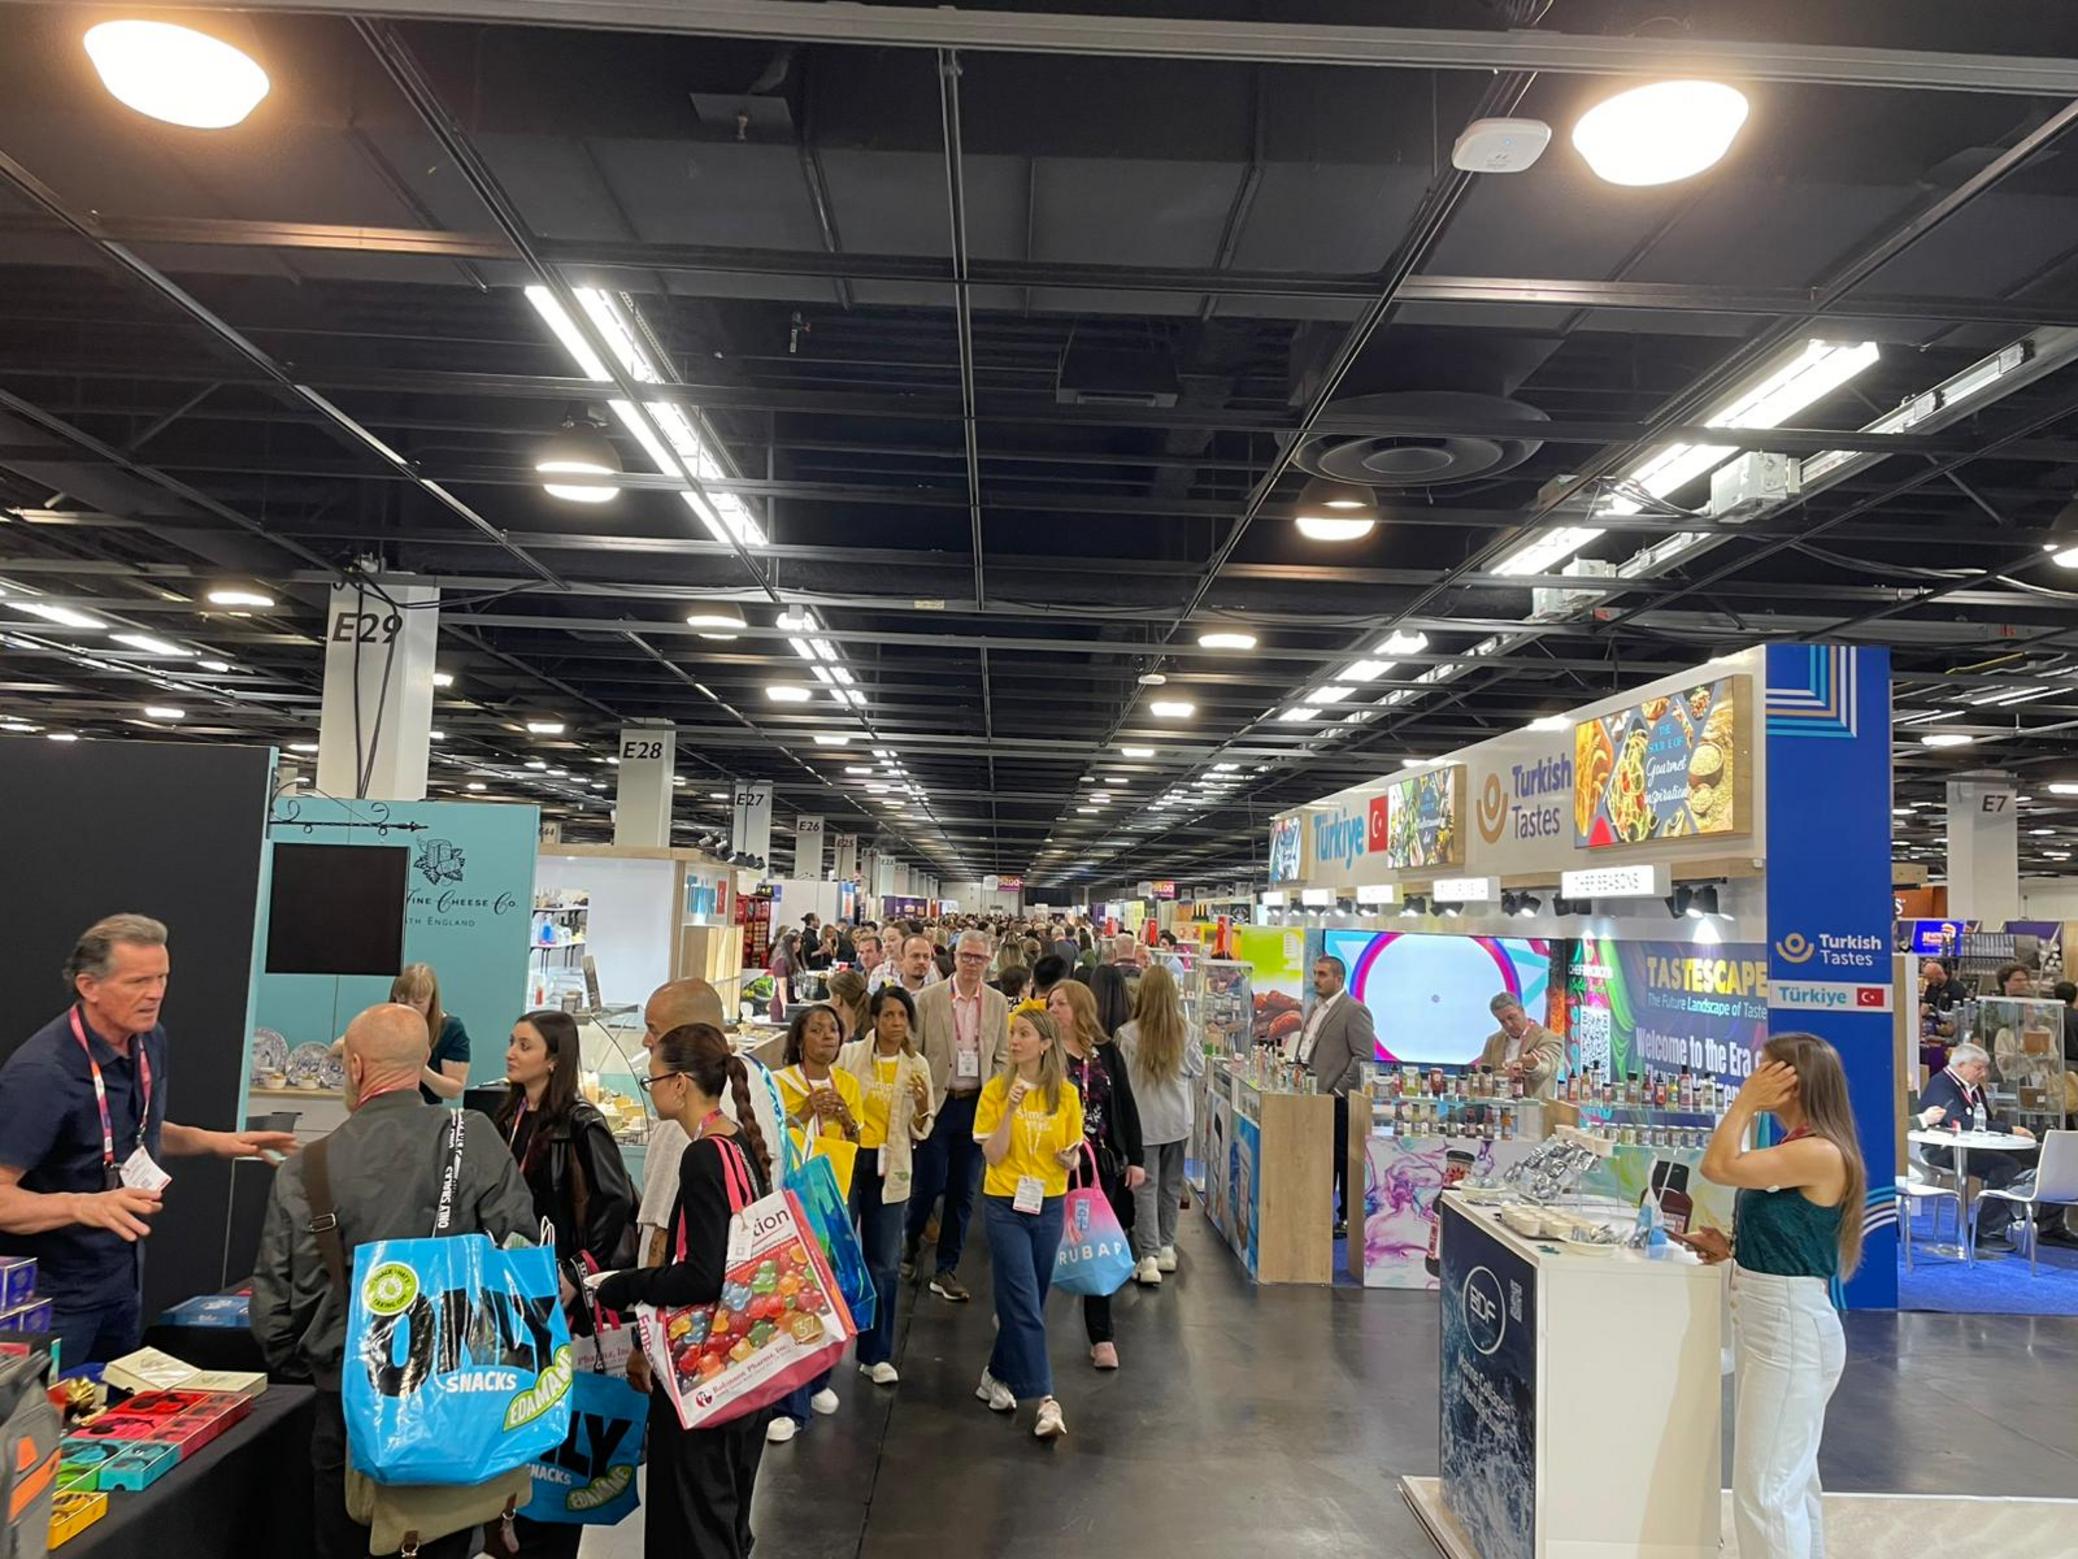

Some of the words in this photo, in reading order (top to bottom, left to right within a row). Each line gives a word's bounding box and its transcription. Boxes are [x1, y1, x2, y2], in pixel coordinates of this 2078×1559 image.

[332, 612, 403, 643] E29
[623, 742, 662, 760] E28
[1512, 753, 1571, 798] Turkish
[1646, 756, 1687, 787] Gourmet
[737, 793, 764, 806] E27
[1982, 794, 2008, 813] E7
[799, 821, 820, 832] E26
[1512, 804, 1560, 839] Tastes
[1314, 809, 1364, 870] Türkiye
[437, 889, 489, 913] CHEESE
[428, 917, 476, 927] ENGLAND
[1819, 934, 1882, 950] Turkish
[1820, 949, 1873, 966] Tastes
[1647, 957, 1767, 998] TASTESCAPE
[1648, 992, 1661, 1006] The
[1662, 994, 1687, 1010] Future
[1687, 997, 1730, 1017] Landscape
[1732, 1001, 1742, 1016] of
[1744, 1003, 1767, 1020] Taste
[1779, 986, 1847, 1007] Türkiye
[1636, 1027, 1687, 1066] Welcome
[1690, 1036, 1703, 1069] to
[1705, 1038, 1727, 1074] the
[1729, 1042, 1751, 1078] Era
[446, 1371, 517, 1393] SNACKS
